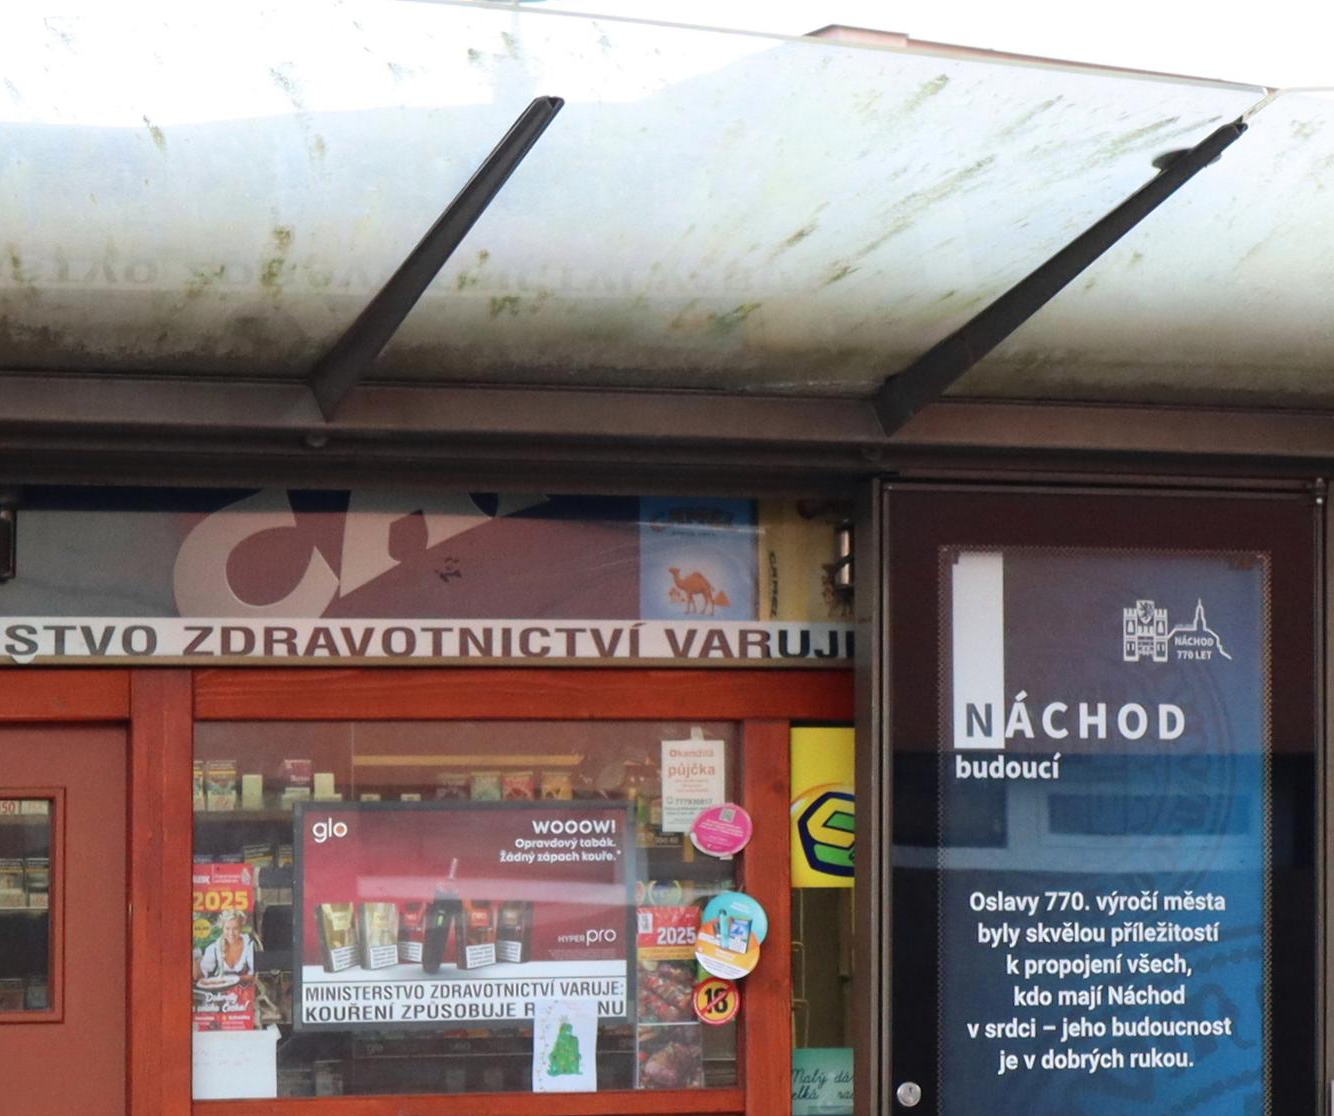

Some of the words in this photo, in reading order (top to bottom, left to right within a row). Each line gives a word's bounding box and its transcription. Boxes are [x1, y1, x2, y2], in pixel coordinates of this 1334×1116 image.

[183, 622, 642, 659] ZDRAVOTNICTVÍ
[1175, 635, 1214, 646] NÁCHOD
[1177, 650, 1194, 659] 770
[1195, 651, 1211, 659] LET
[966, 690, 1185, 740] NÁCHOD
[956, 752, 1061, 778] budoucí
[312, 818, 347, 843] glo
[532, 820, 615, 834] WOOOW!
[515, 838, 577, 849] Opravdový
[580, 837, 615, 848] tabák.
[500, 850, 534, 864] Žádný
[537, 851, 579, 864] zápach
[193, 891, 248, 910] 2025
[970, 891, 1039, 916] Oslavy
[1045, 892, 1089, 910] 770.
[1096, 891, 1158, 915] výročí
[1164, 891, 1225, 910] města
[586, 930, 616, 946] pro
[657, 927, 696, 944] 2025
[978, 923, 1020, 947] byly
[1026, 922, 1105, 942] skvělou
[1112, 922, 1219, 946] příležitostí
[1007, 954, 1019, 974] k
[1025, 954, 1122, 979] propojení
[1127, 953, 1191, 976] všech,
[306, 985, 424, 1000] MINISTERSTVO
[431, 980, 554, 1000] ZDRAVOTNICTVÍ
[561, 981, 624, 997] VARUJE:
[1015, 986, 1052, 1006] kdo
[1059, 985, 1103, 1010] mají
[1108, 985, 1185, 1004] Náchod
[306, 1001, 393, 1021] KOUŘENÍ
[402, 1000, 515, 1019] ZPŮSOBUJE
[967, 1024, 979, 1038] v
[985, 1018, 1035, 1038] srdci
[1061, 1017, 1106, 1042] jeho
[1112, 1016, 1231, 1036] budoucnost
[998, 1050, 1018, 1075] je
[1024, 1055, 1035, 1069] v
[1042, 1048, 1124, 1073] dobrých
[1131, 1048, 1193, 1067] rukou.
